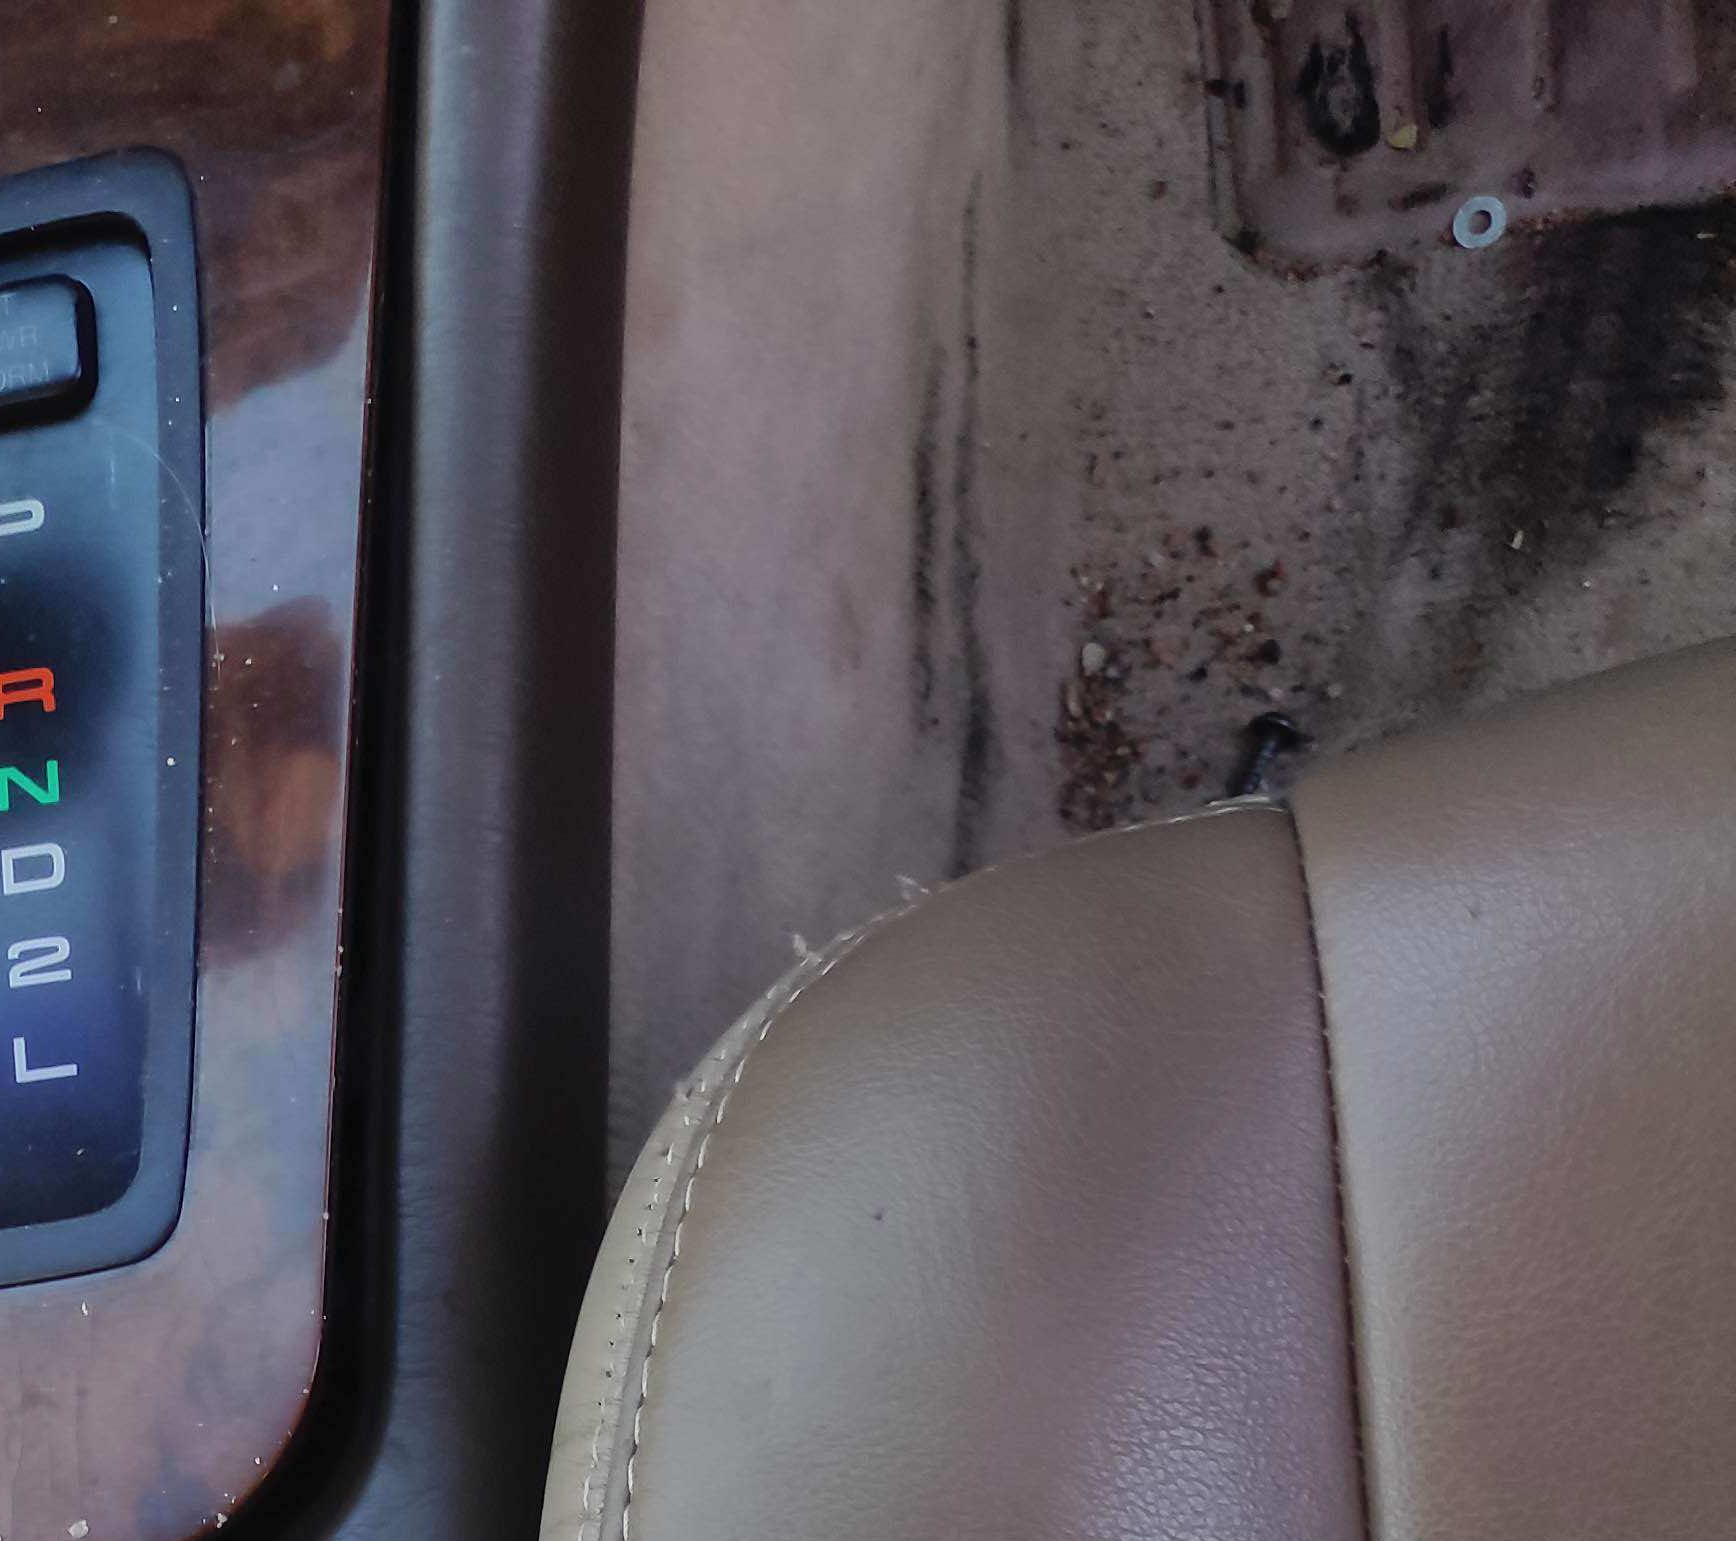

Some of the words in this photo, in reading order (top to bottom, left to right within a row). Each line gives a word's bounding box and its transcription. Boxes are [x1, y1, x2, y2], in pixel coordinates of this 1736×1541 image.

[1, 842, 67, 896] D
[7, 935, 73, 989] 2
[13, 1036, 78, 1084] L
